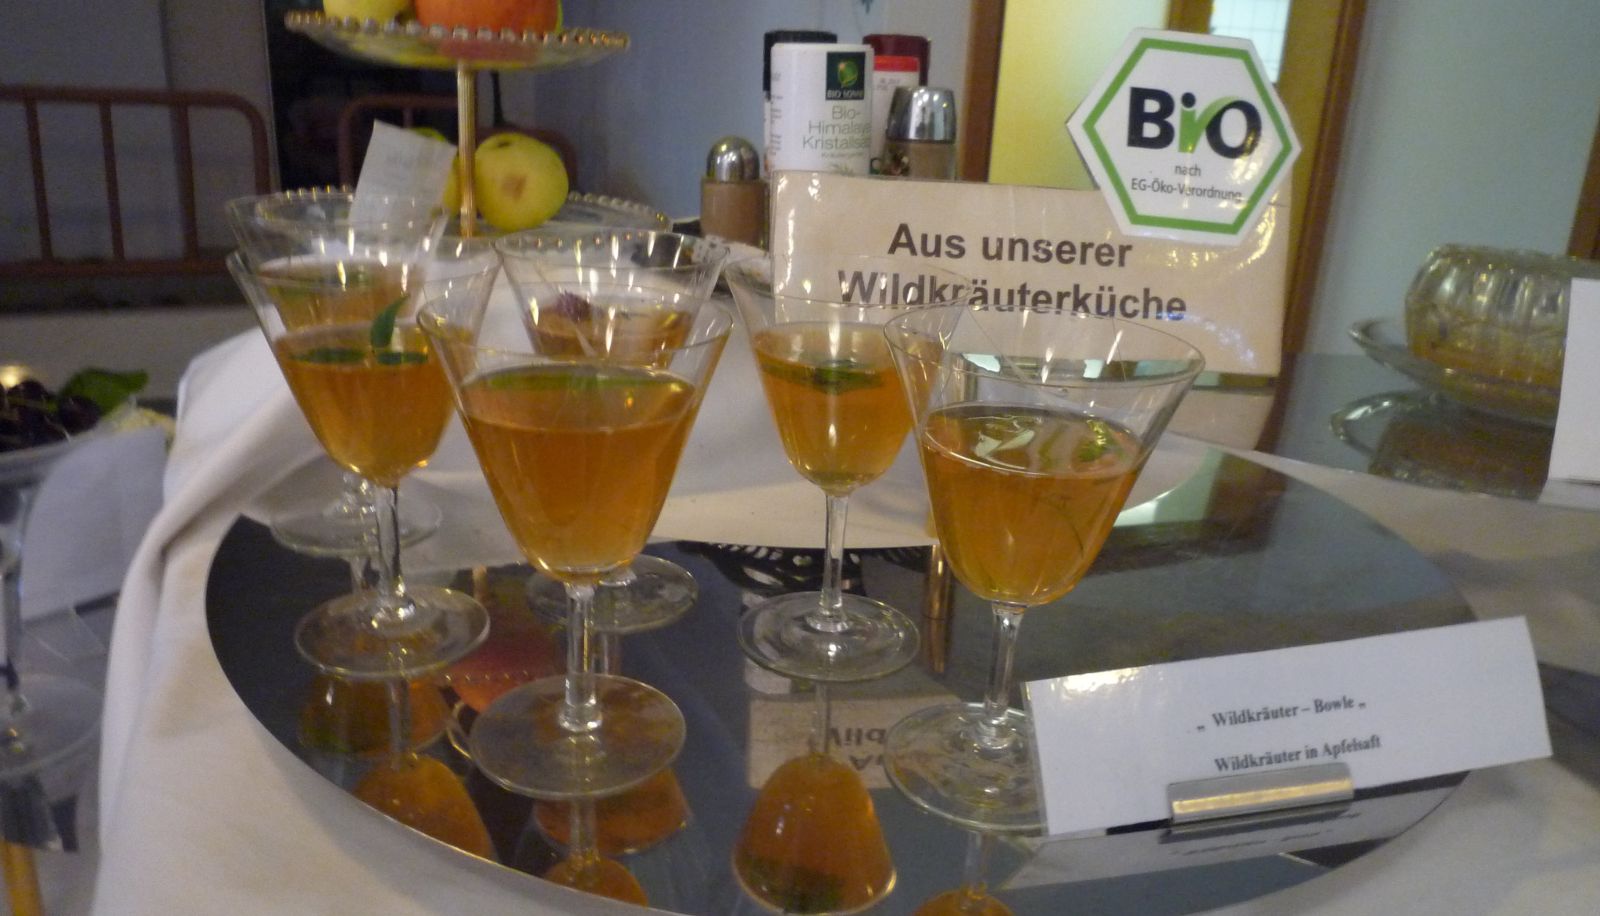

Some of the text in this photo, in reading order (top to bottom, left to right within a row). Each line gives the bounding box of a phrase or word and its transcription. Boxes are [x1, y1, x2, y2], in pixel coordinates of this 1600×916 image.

[831, 105, 860, 120] Bio-
[1174, 163, 1202, 176] nach
[1131, 178, 1243, 203] EG-Öko-Verordnung
[887, 222, 1133, 268] Aus unserer
[837, 269, 1187, 320] Wildkräuterküche
[1211, 706, 1299, 727] Wildkräuter
[1313, 695, 1355, 714] Bowle
[1214, 734, 1381, 772] Wildkräuter in Apfelsaft
